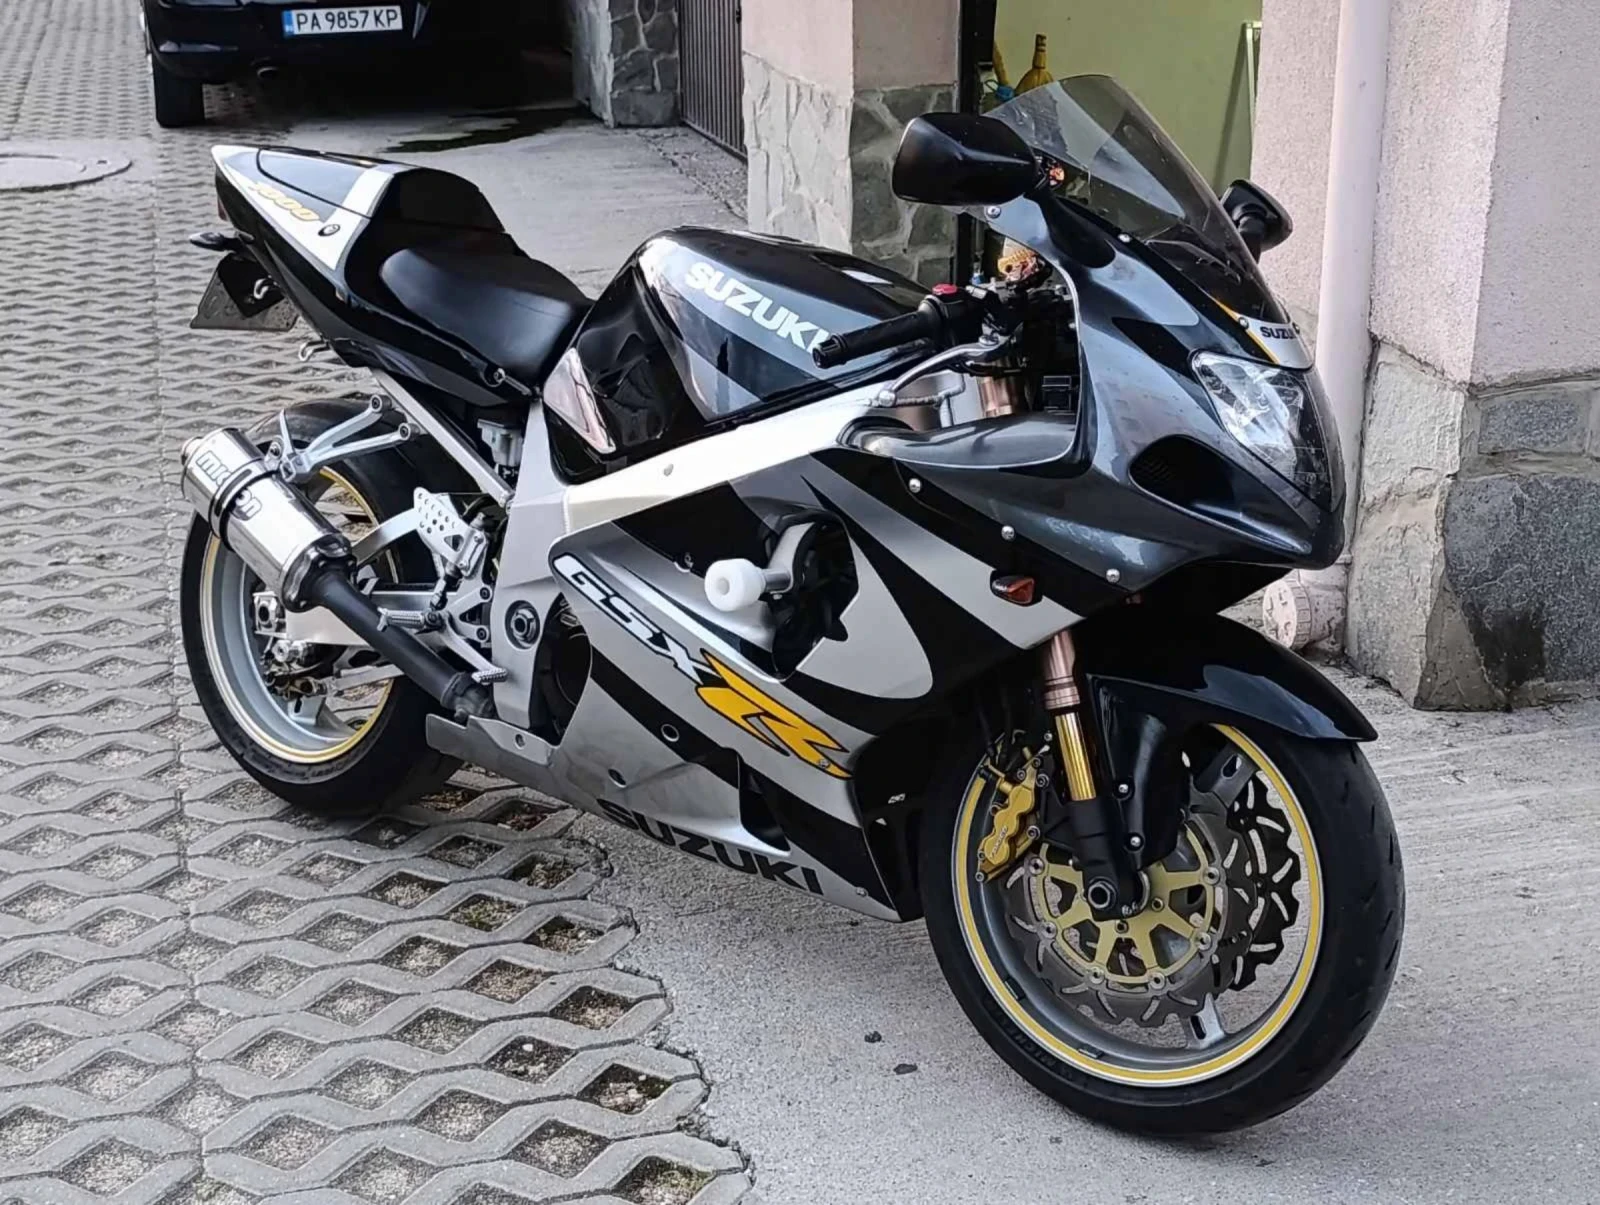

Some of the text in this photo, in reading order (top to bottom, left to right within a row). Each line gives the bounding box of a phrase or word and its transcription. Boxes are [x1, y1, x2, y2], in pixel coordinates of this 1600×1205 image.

[296, 12, 321, 31] PA
[325, 10, 369, 30] 9857
[373, 9, 398, 28] KP
[596, 798, 824, 896] SUZUKI
